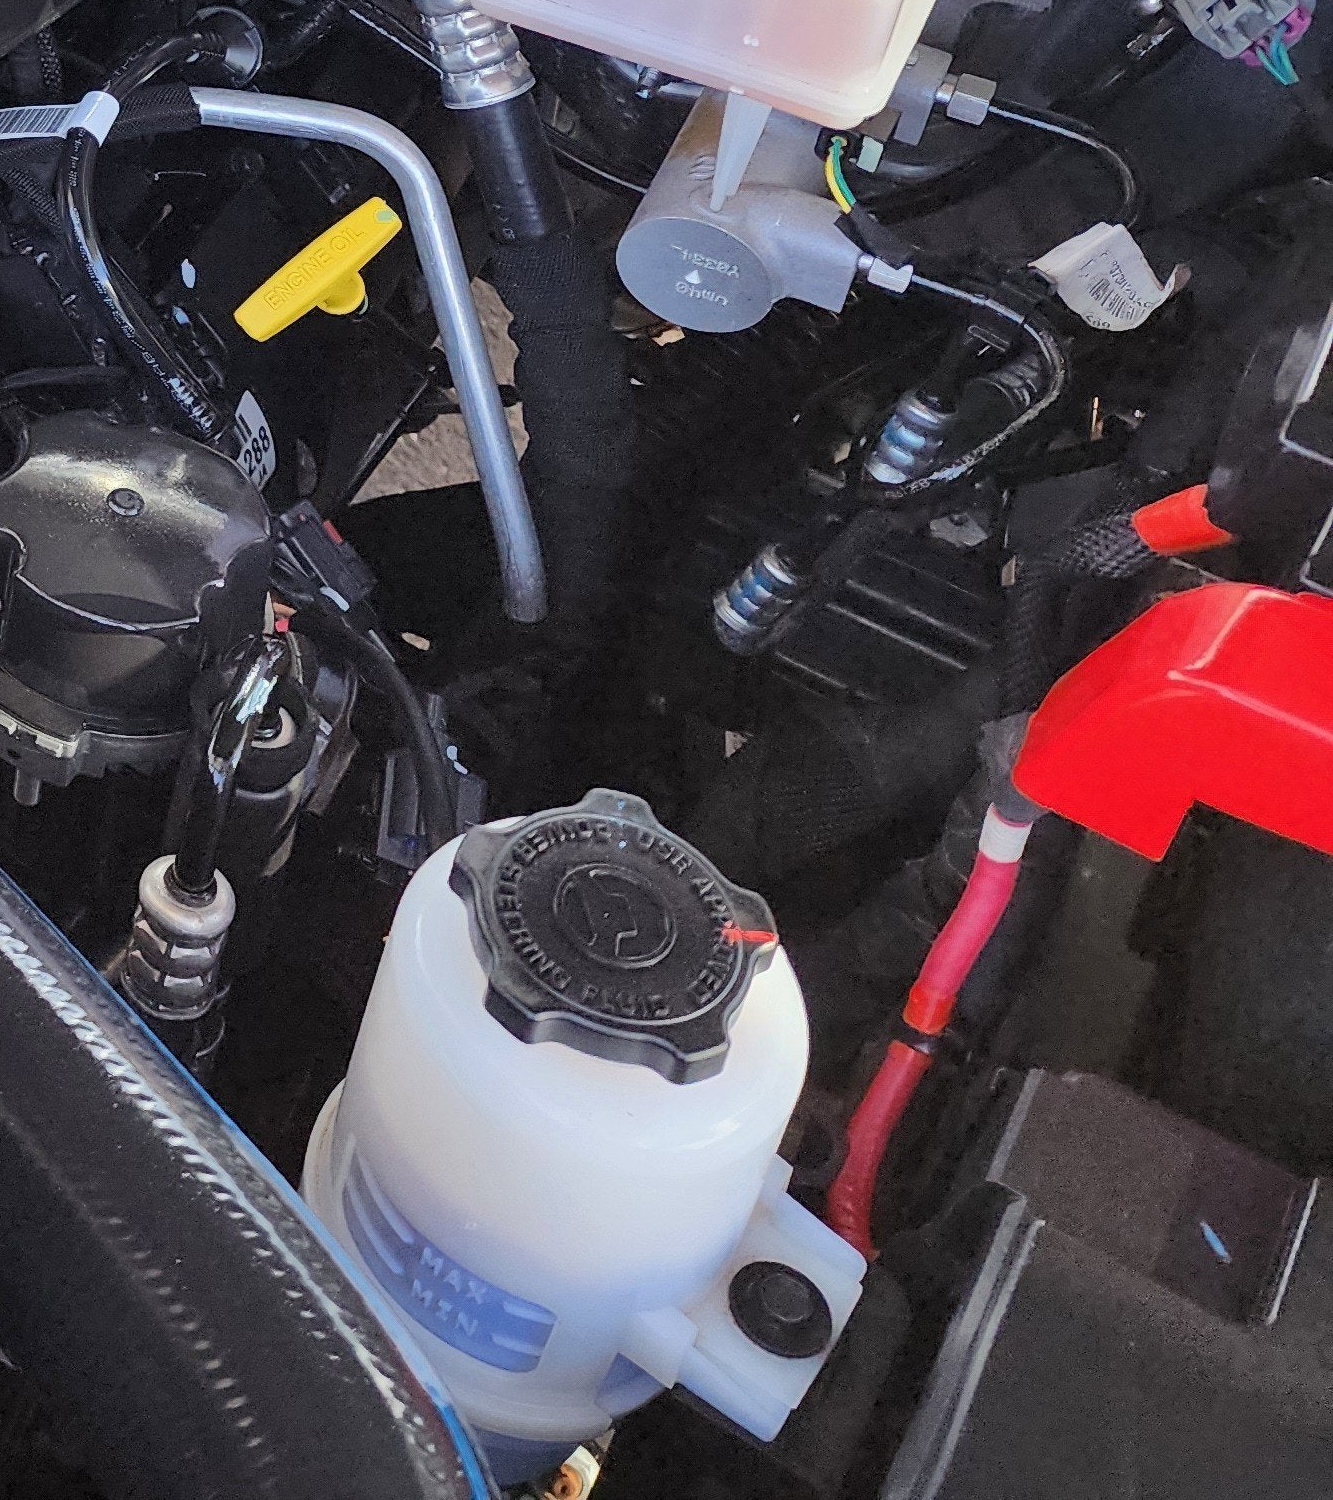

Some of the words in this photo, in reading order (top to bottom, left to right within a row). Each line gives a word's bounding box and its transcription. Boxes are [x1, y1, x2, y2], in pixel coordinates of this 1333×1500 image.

[263, 247, 334, 311] ENGINE
[329, 227, 365, 253] OIL
[244, 425, 270, 478] 288
[419, 1246, 488, 1305] MAX
[412, 1278, 479, 1337] MIN
